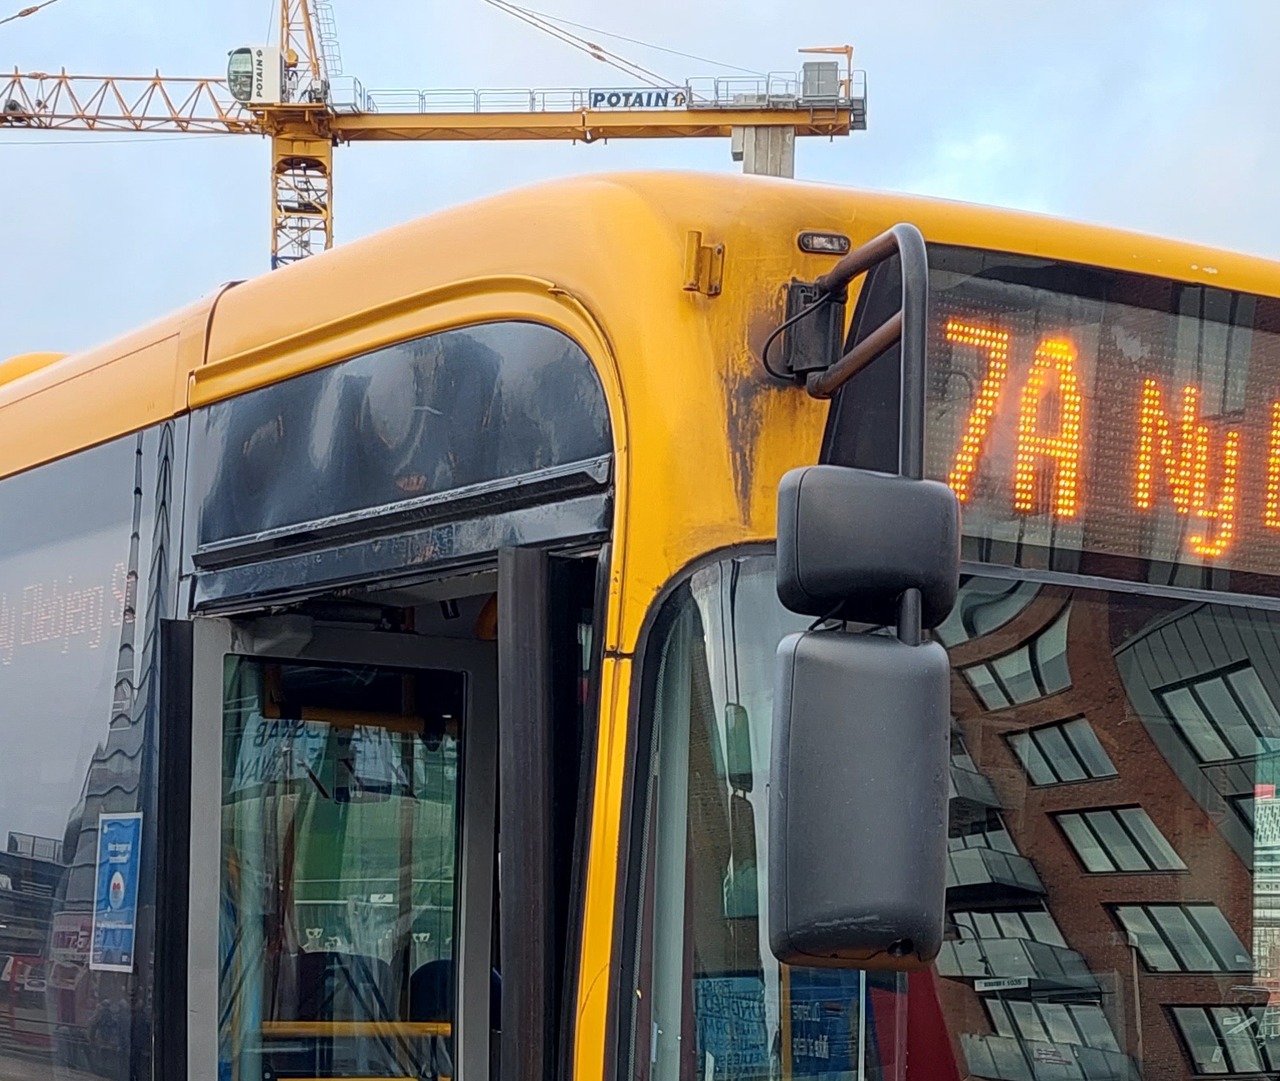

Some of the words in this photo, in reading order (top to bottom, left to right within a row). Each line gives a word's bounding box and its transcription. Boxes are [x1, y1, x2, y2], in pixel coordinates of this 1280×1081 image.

[255, 58, 264, 97] POTAIN
[592, 92, 669, 107] POTAIN
[946, 319, 1082, 518] 7A
[1136, 378, 1240, 558] Ny
